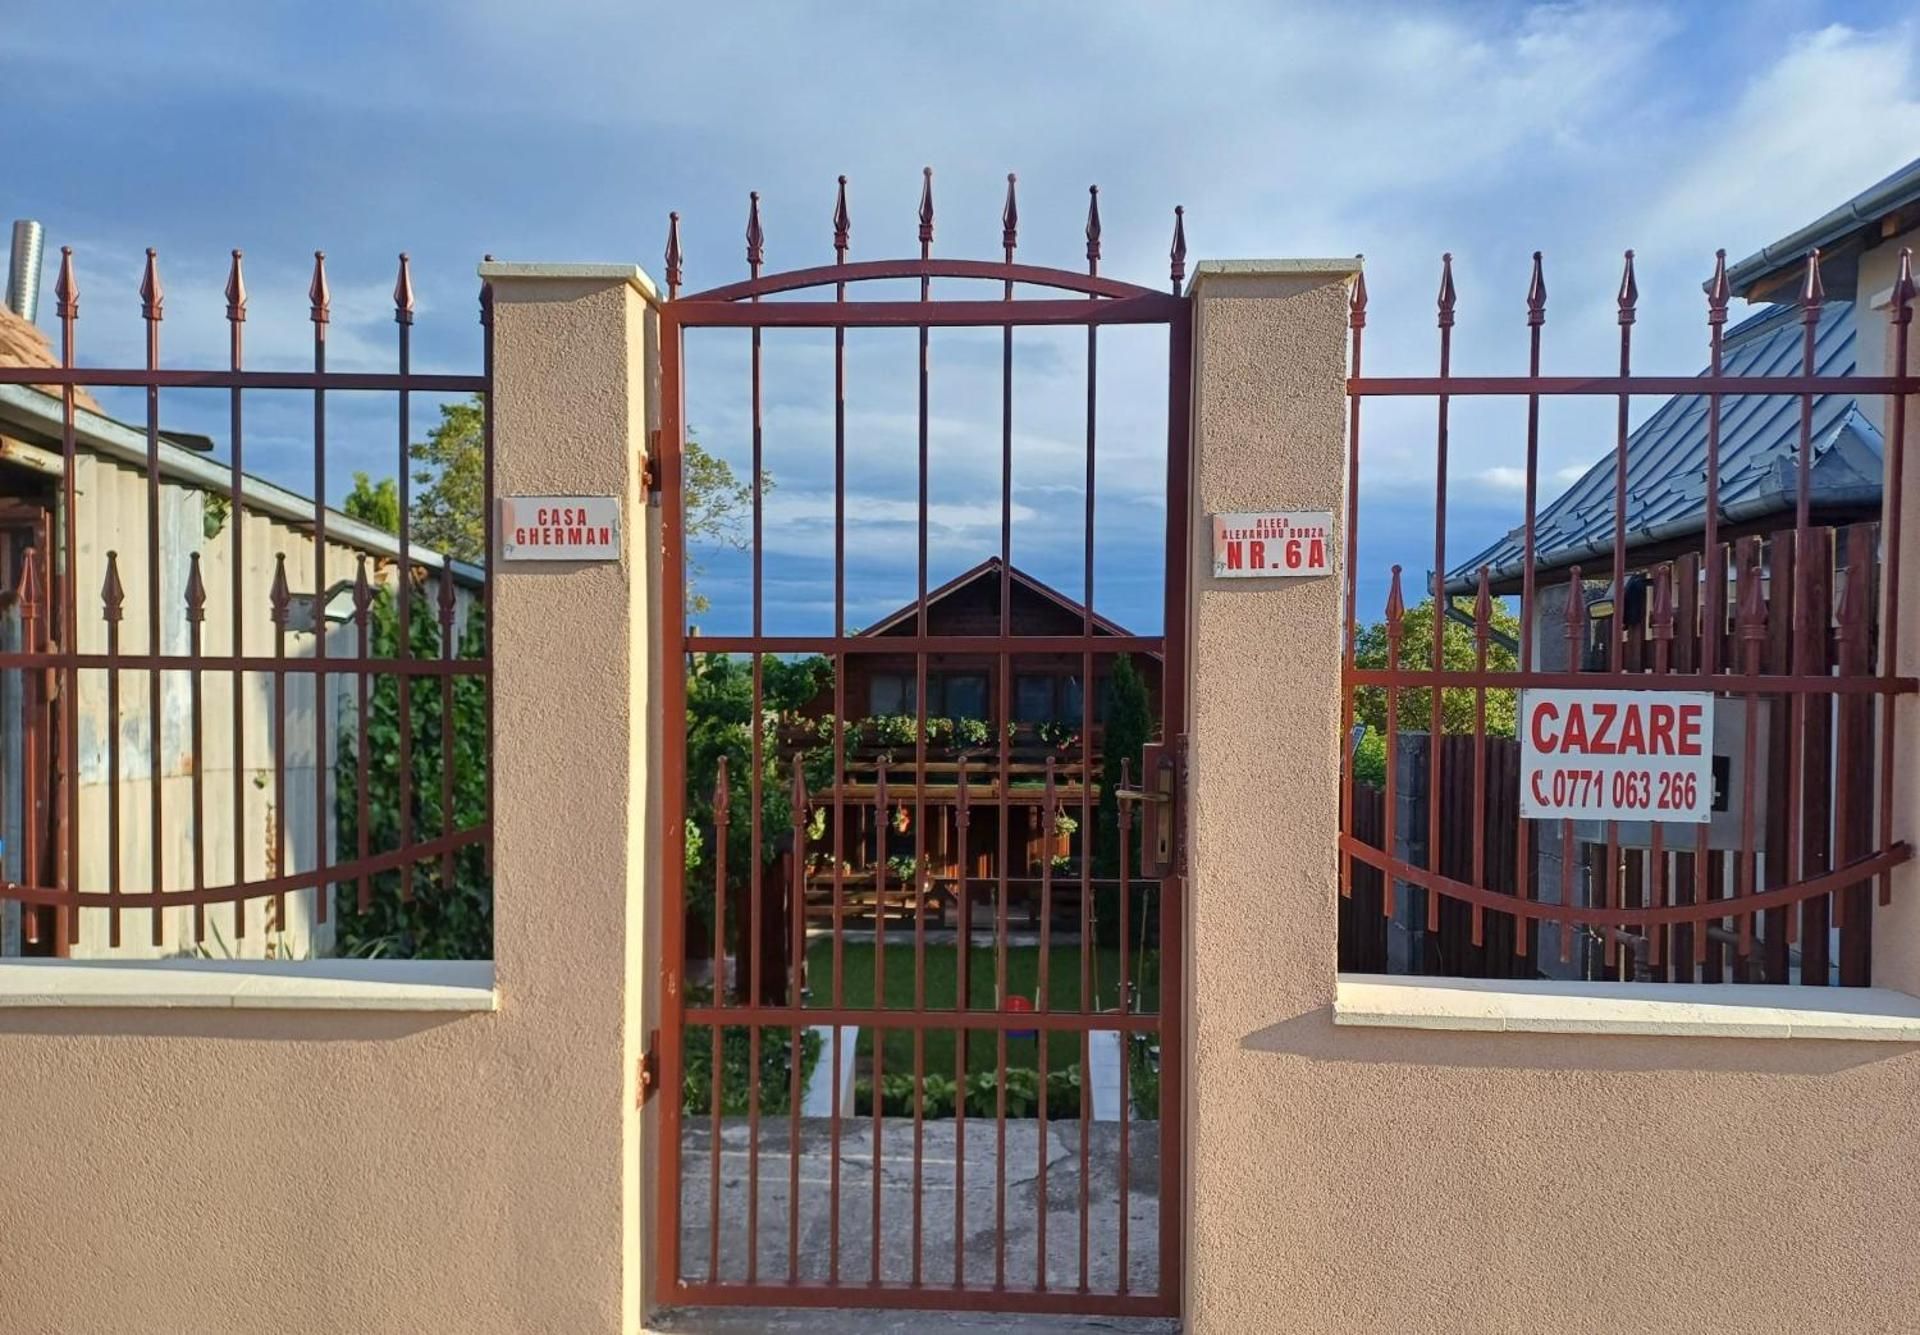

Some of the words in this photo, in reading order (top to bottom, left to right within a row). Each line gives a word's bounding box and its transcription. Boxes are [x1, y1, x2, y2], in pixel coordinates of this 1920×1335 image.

[538, 509, 587, 526] CASA
[1256, 518, 1289, 528] ALEEA
[516, 528, 609, 545] GHERMAN
[1531, 702, 1702, 755] CAZARE
[1553, 769, 1603, 808] 0771
[1612, 770, 1651, 810] 063
[1657, 771, 1697, 810] 266
